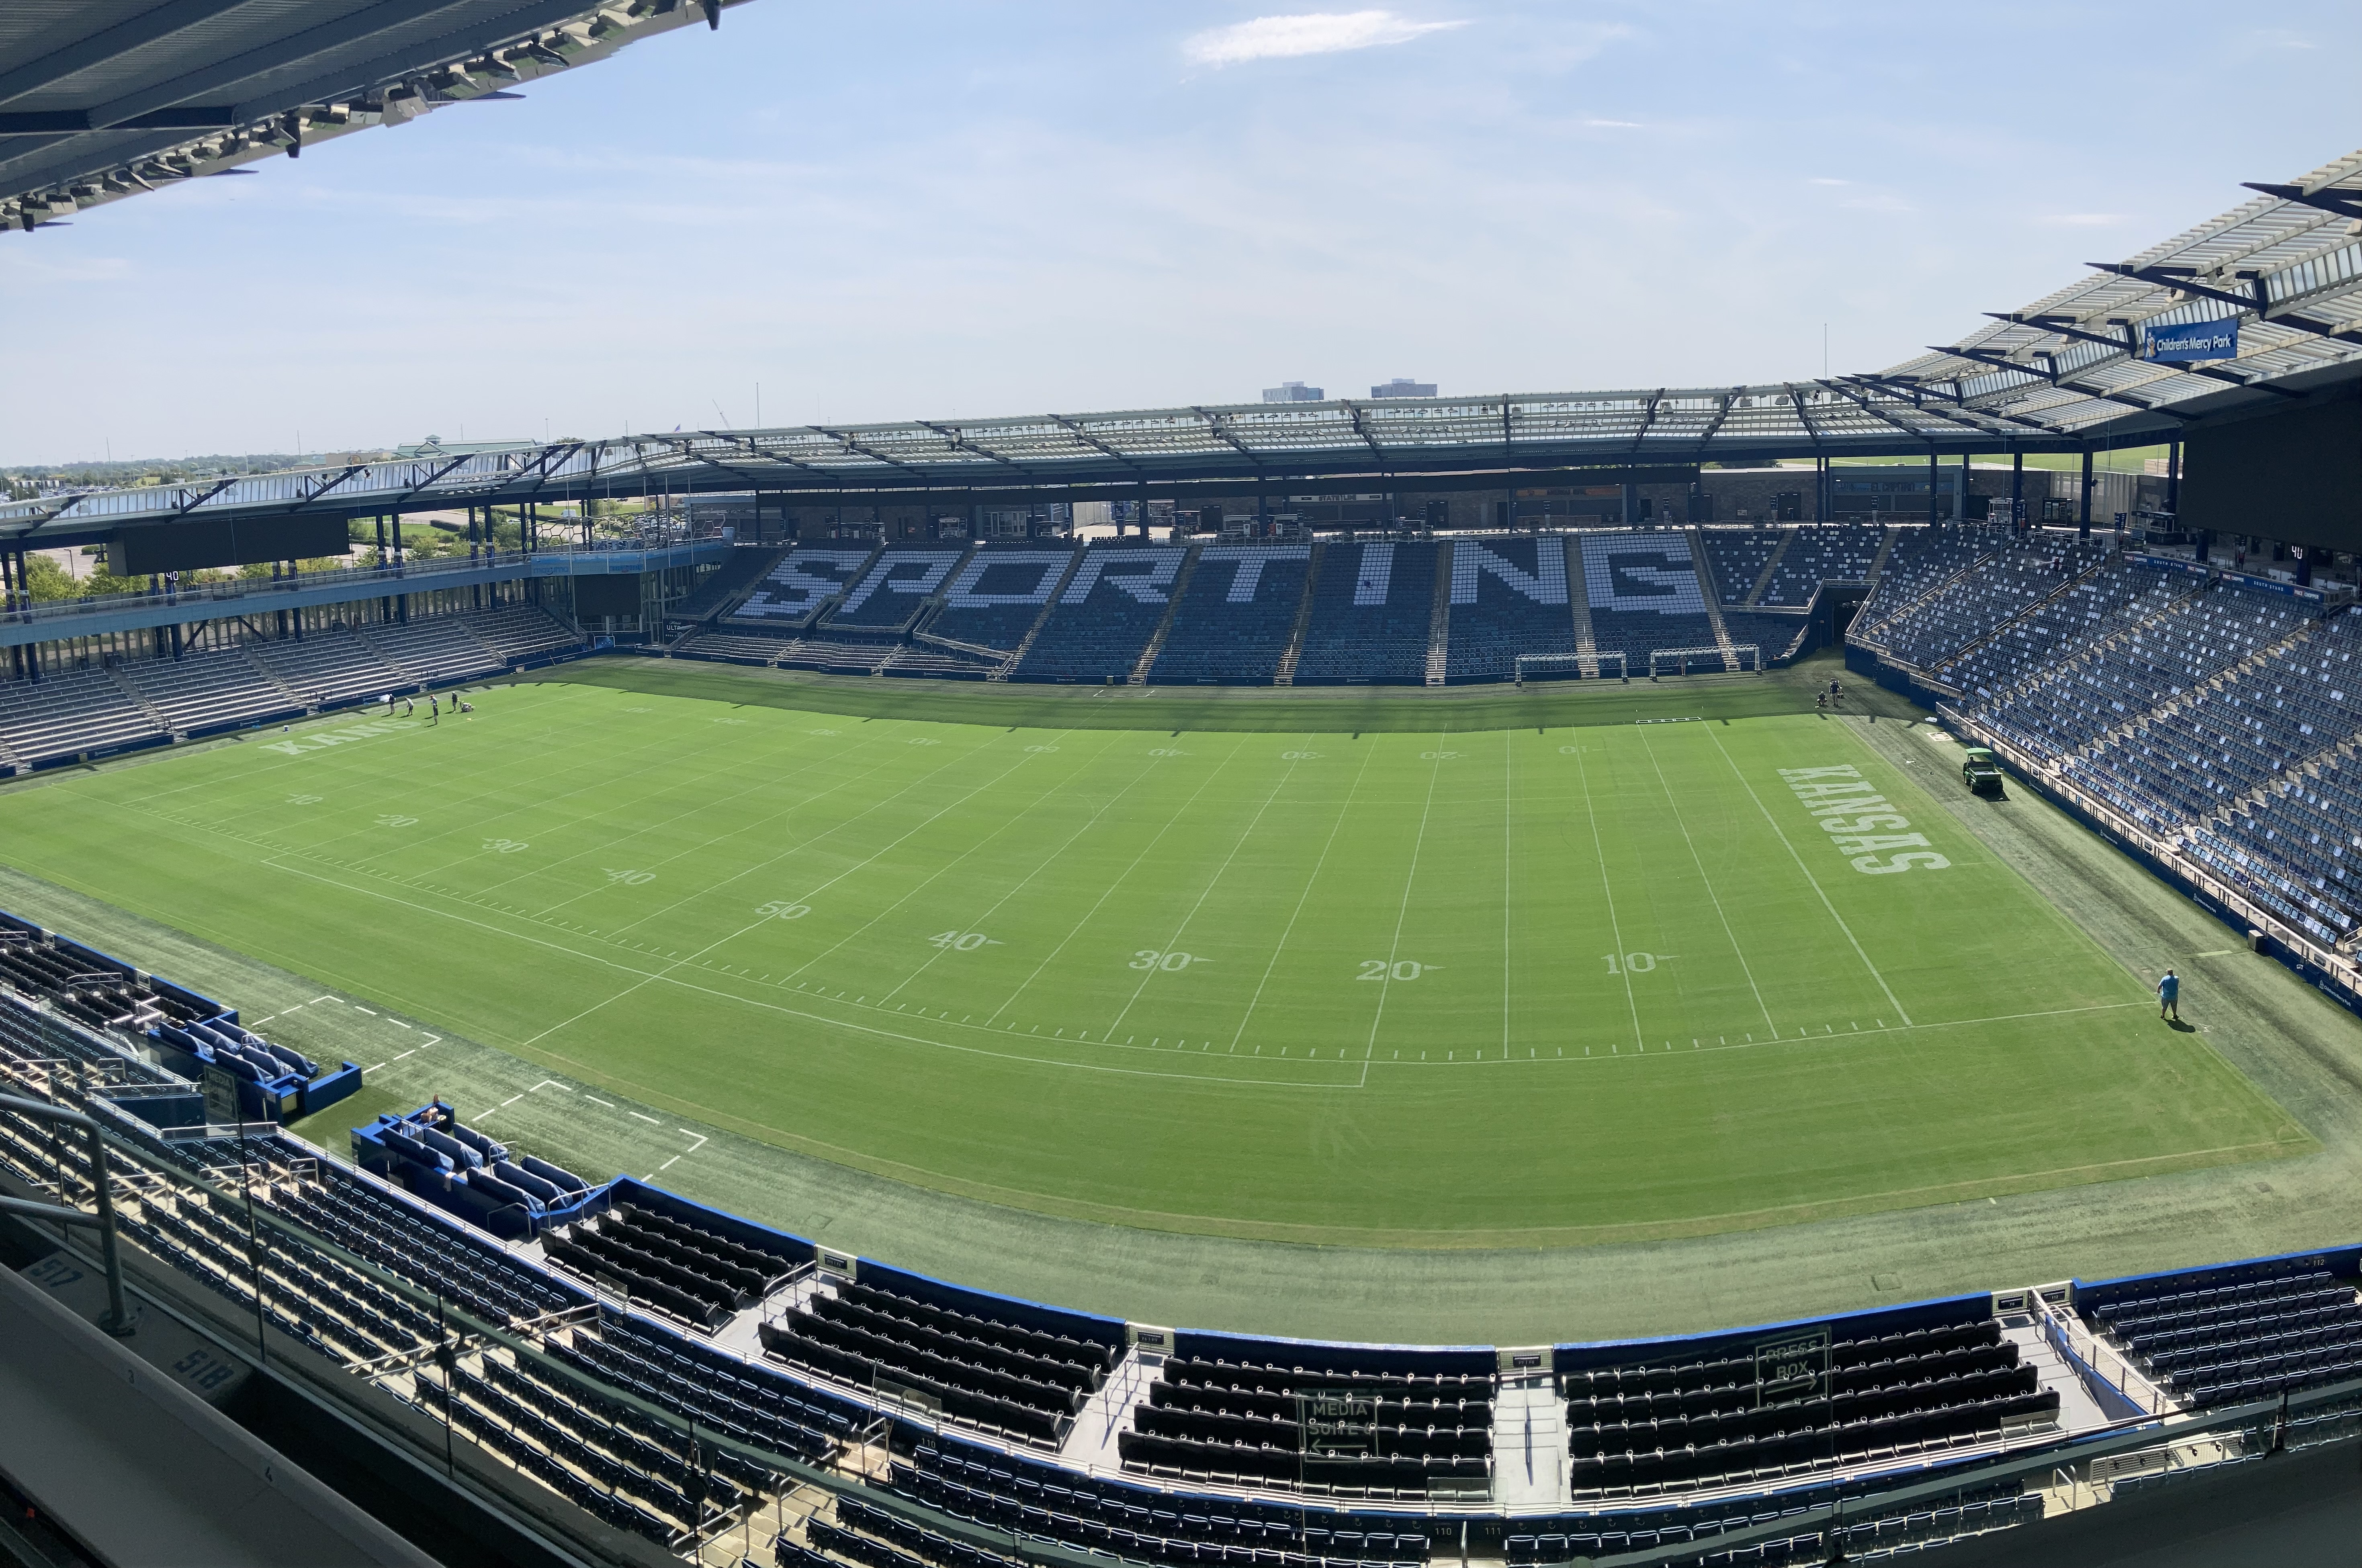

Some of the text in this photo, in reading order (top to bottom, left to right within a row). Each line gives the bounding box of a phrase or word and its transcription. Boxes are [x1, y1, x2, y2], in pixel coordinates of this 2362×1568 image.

[2157, 333, 2231, 352] Children's Mercy Park
[166, 571, 179, 581] 40
[735, 533, 1707, 616] SPORTING
[258, 719, 422, 755] KANS
[1148, 748, 1184, 757] 40
[1281, 751, 1318, 760] 30
[1420, 751, 1459, 760] 20
[1558, 745, 1588, 754] 10
[373, 814, 420, 827] 20
[1776, 764, 1952, 874] KANSAS
[482, 839, 529, 854] 30
[607, 869, 656, 885] 40
[754, 900, 811, 919] 50
[928, 930, 987, 950] 40
[1128, 950, 1193, 972] 30
[1601, 952, 1657, 974] 10
[1356, 960, 1422, 981] 20
[2324, 985, 2336, 997] Children's
[2336, 993, 2345, 1003] Mercy
[596, 1310, 605, 1320] 18
[1766, 1340, 1818, 1363] PRESS
[1777, 1360, 1808, 1379] BOX
[1313, 1402, 1367, 1416] MEDIA
[1309, 1422, 1359, 1435] SUITE
[921, 1438, 935, 1448] 110
[1435, 1527, 1452, 1535] 110
[1486, 1527, 1501, 1535] 111
